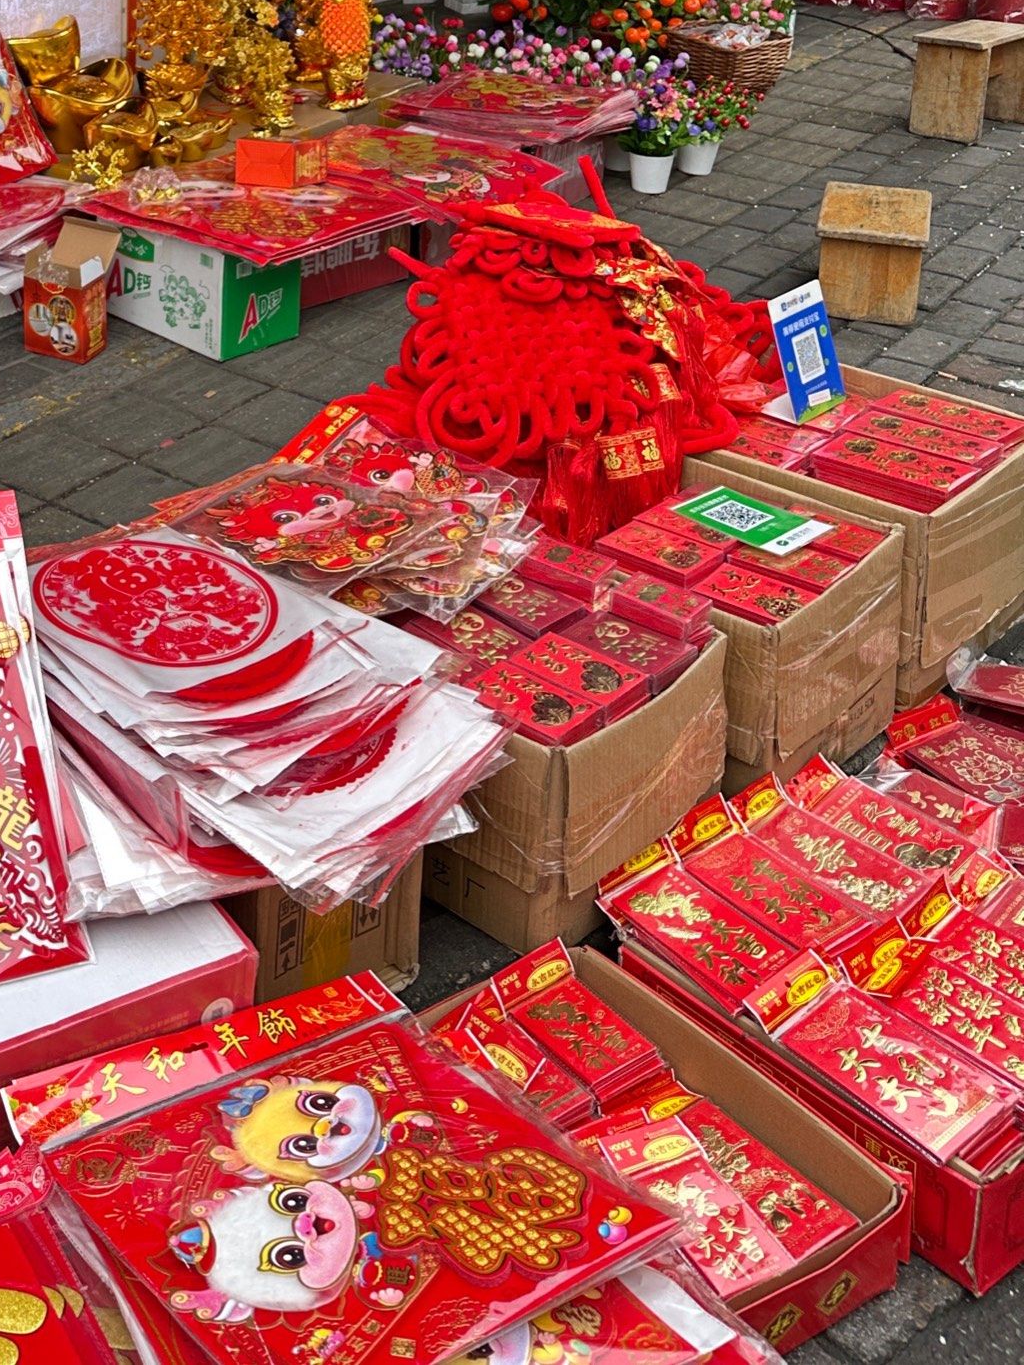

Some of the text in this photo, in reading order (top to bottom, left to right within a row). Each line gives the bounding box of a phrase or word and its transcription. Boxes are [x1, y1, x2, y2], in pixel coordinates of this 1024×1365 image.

[641, 437, 660, 463] 福
[101, 1009, 298, 1105] 天和年飾
